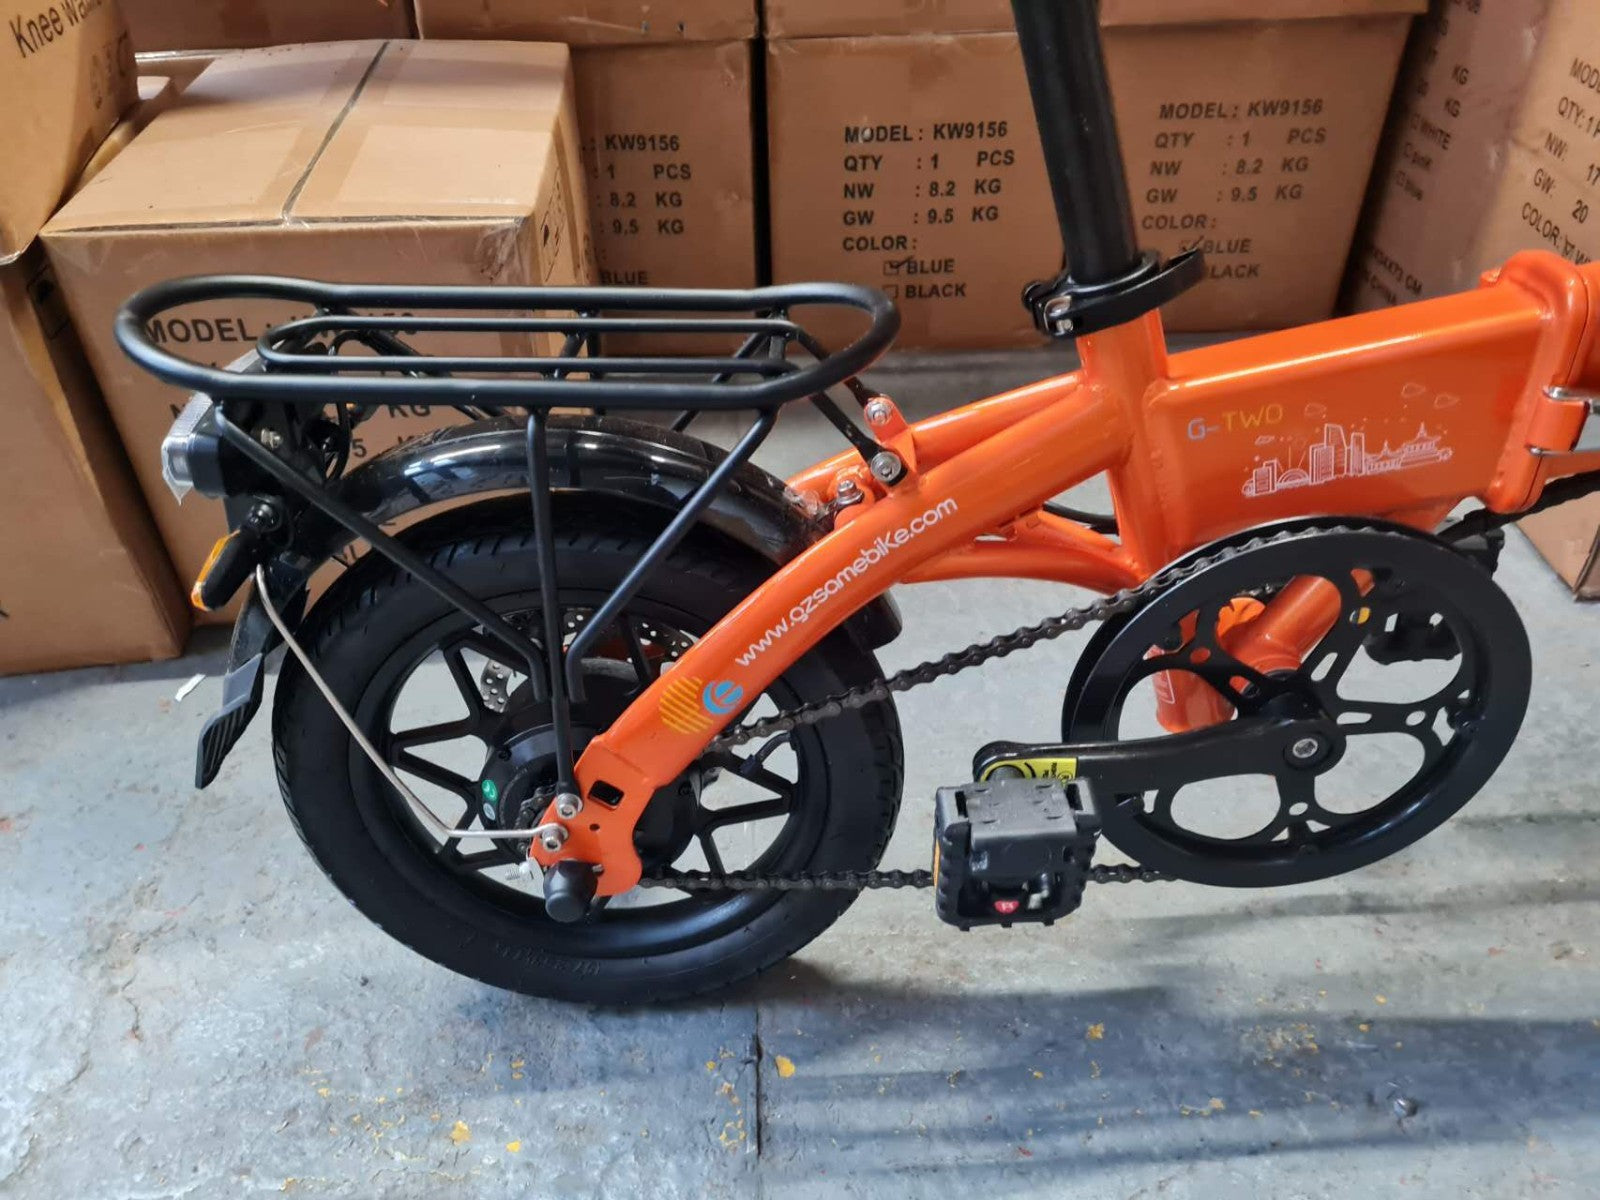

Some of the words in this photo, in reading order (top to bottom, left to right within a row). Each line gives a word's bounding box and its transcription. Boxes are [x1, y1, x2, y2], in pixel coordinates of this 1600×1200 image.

[9, 7, 64, 58] Knee
[1248, 98, 1323, 117] KW9156
[1558, 96, 1585, 129] QTY:
[933, 121, 1008, 140] KW9156
[1155, 132, 1194, 148] QTY
[1287, 127, 1327, 144] PCS
[604, 134, 680, 151] KW9156
[844, 154, 883, 172] QTY
[976, 150, 1015, 167] PCS
[1150, 160, 1182, 176] NW
[1236, 158, 1263, 174] 8.2
[1282, 156, 1309, 172] KG
[653, 163, 692, 180] PCS
[844, 183, 874, 199] NW
[929, 181, 956, 197] 8.2
[974, 179, 1001, 195] KG
[1146, 188, 1178, 203] GW
[1231, 186, 1258, 201] 9.5
[1275, 184, 1303, 200] KG
[1534, 168, 1556, 199] GW:
[610, 191, 636, 207] 8.2
[656, 191, 682, 207] KG
[843, 210, 874, 226] GW
[927, 208, 954, 224] 9.5
[972, 206, 999, 222] KG
[1572, 199, 1589, 224] 20
[612, 218, 639, 235] 9.5
[658, 218, 684, 234] KG
[1203, 238, 1252, 254] BLUE
[906, 258, 955, 275] BLUE
[905, 283, 967, 299] BLACK
[1187, 403, 1283, 442] G-TWO
[735, 496, 959, 668] www.gzsamebike.com
